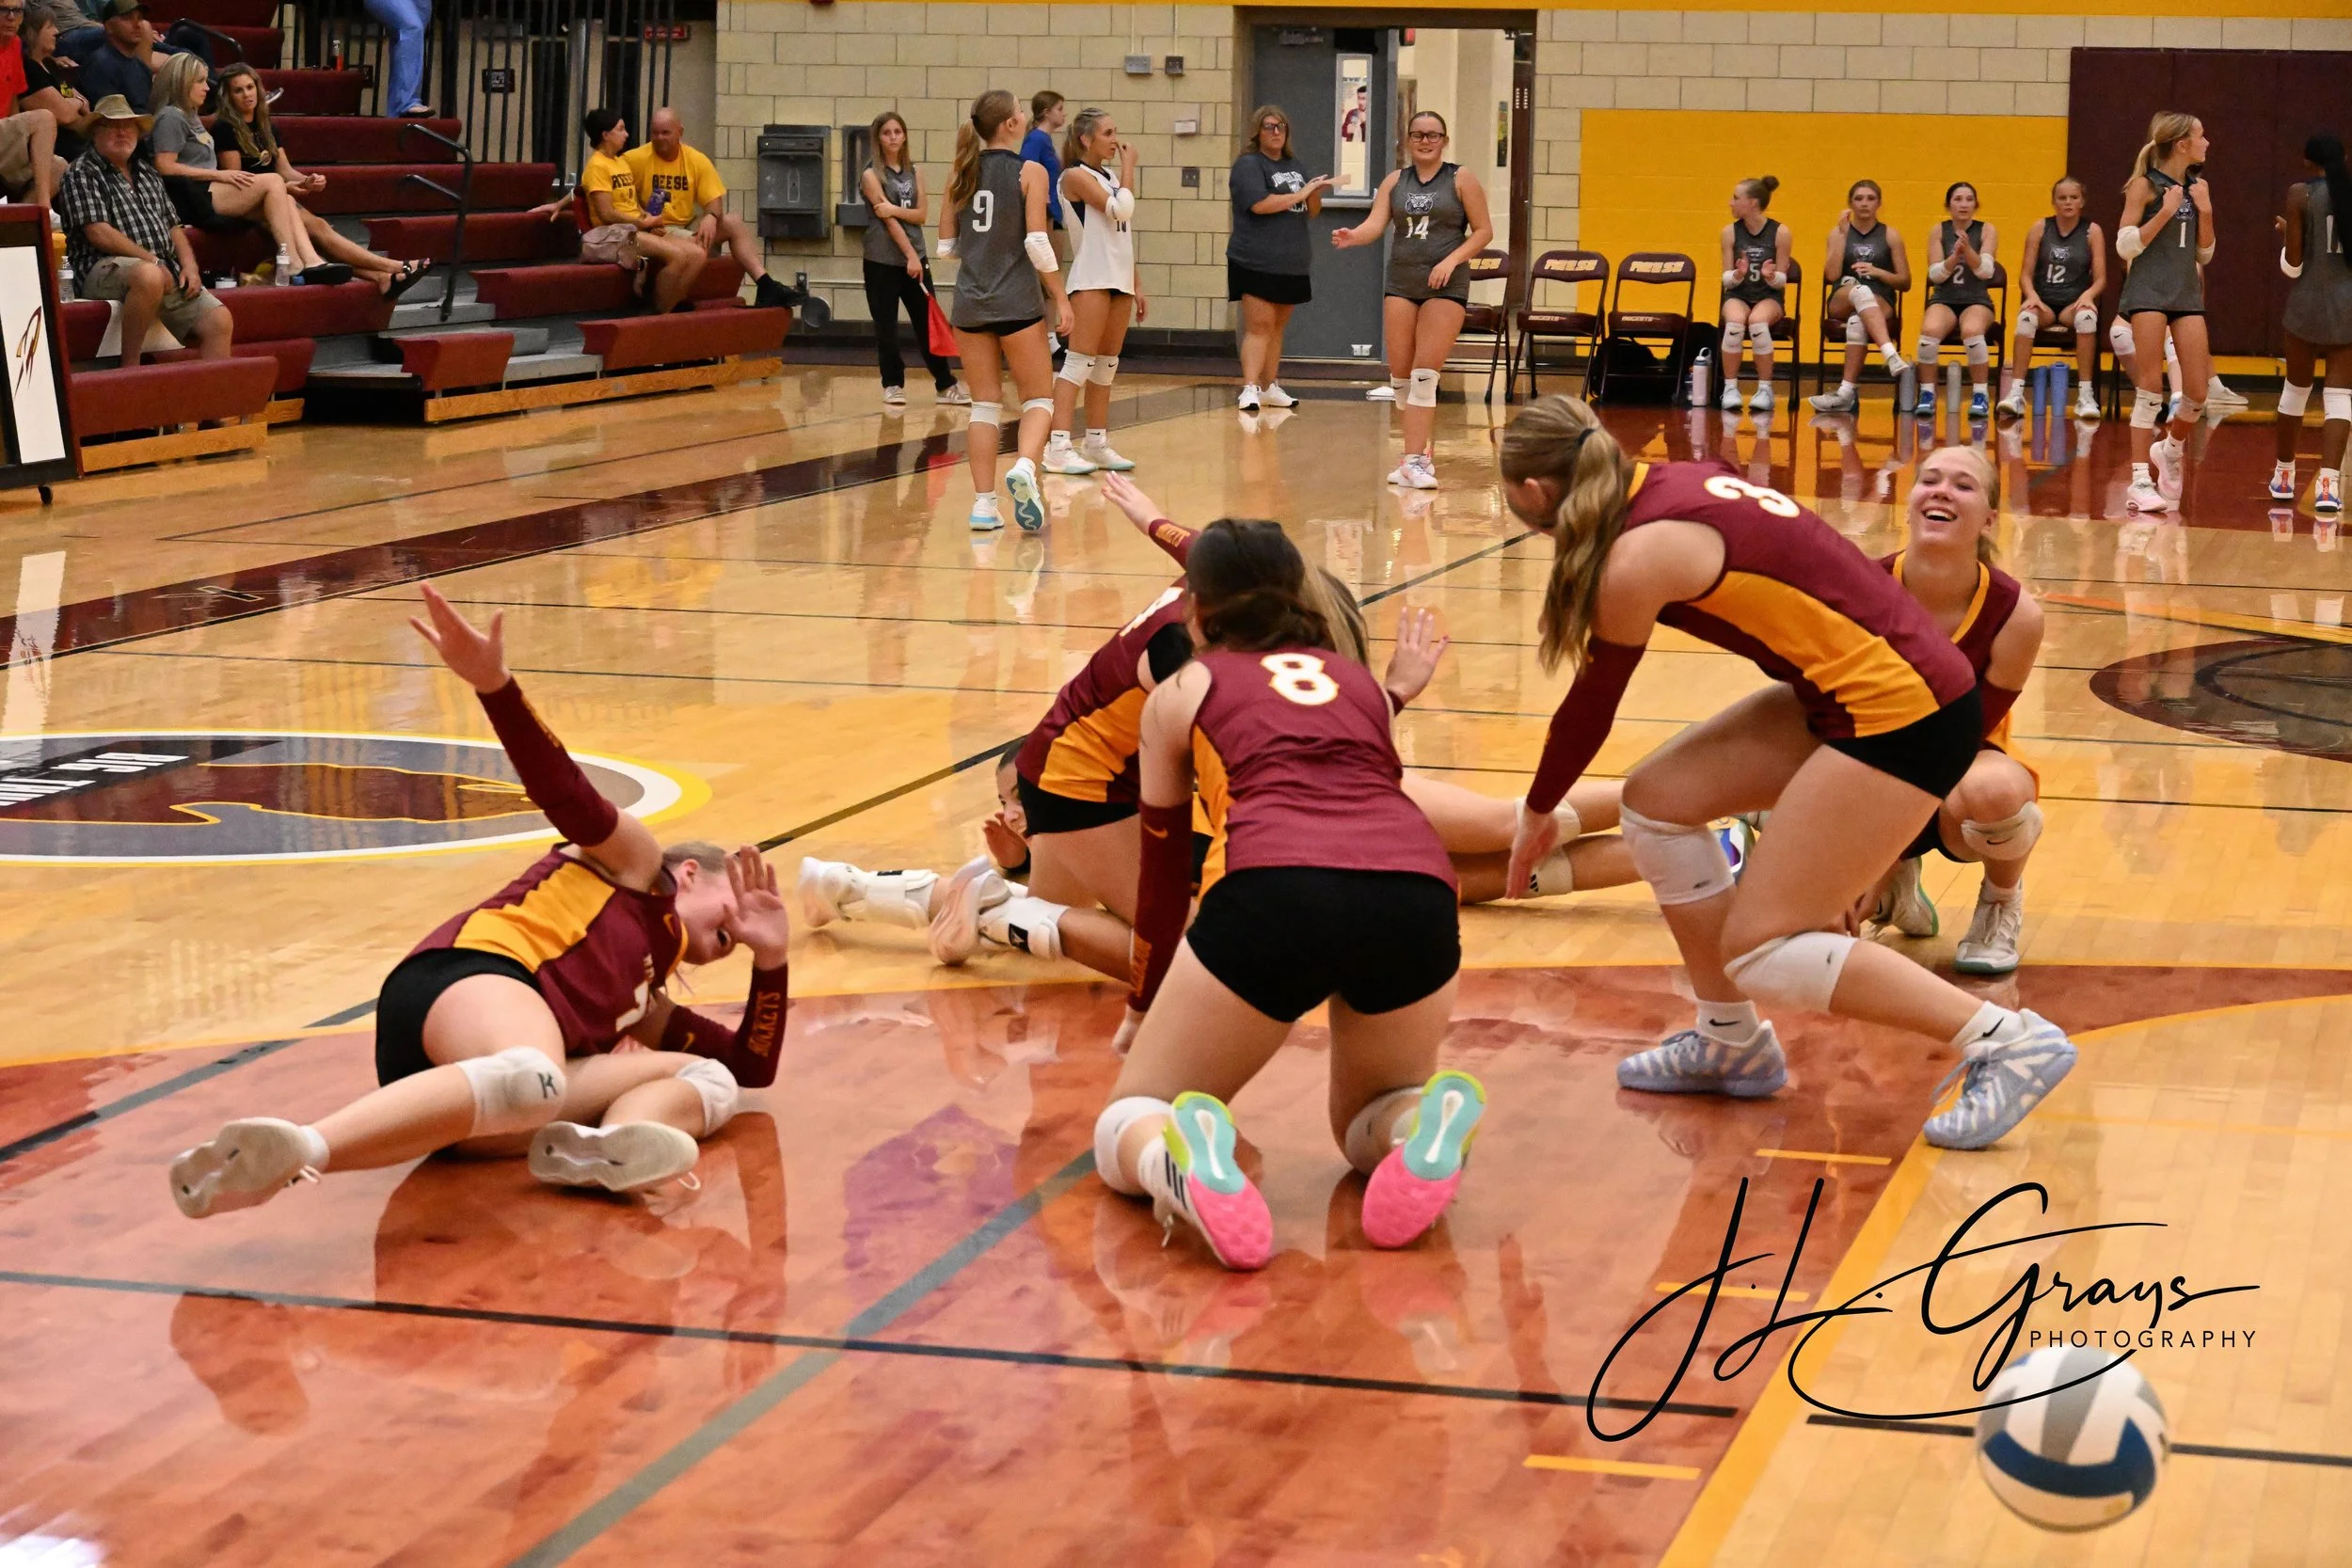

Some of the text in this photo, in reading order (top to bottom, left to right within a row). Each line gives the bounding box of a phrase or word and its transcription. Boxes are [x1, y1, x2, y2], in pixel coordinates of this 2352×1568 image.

[972, 189, 994, 232] 9
[1405, 215, 1430, 240] 14
[2179, 221, 2186, 248] 1
[2326, 214, 2344, 254] 1
[1544, 259, 1598, 272] REESE
[1629, 261, 1685, 274] REESE
[1749, 262, 1761, 282] 5
[1952, 264, 1964, 284] 2
[2045, 263, 2067, 284] 12
[1704, 475, 1801, 518] 3
[1260, 652, 1341, 706] 8
